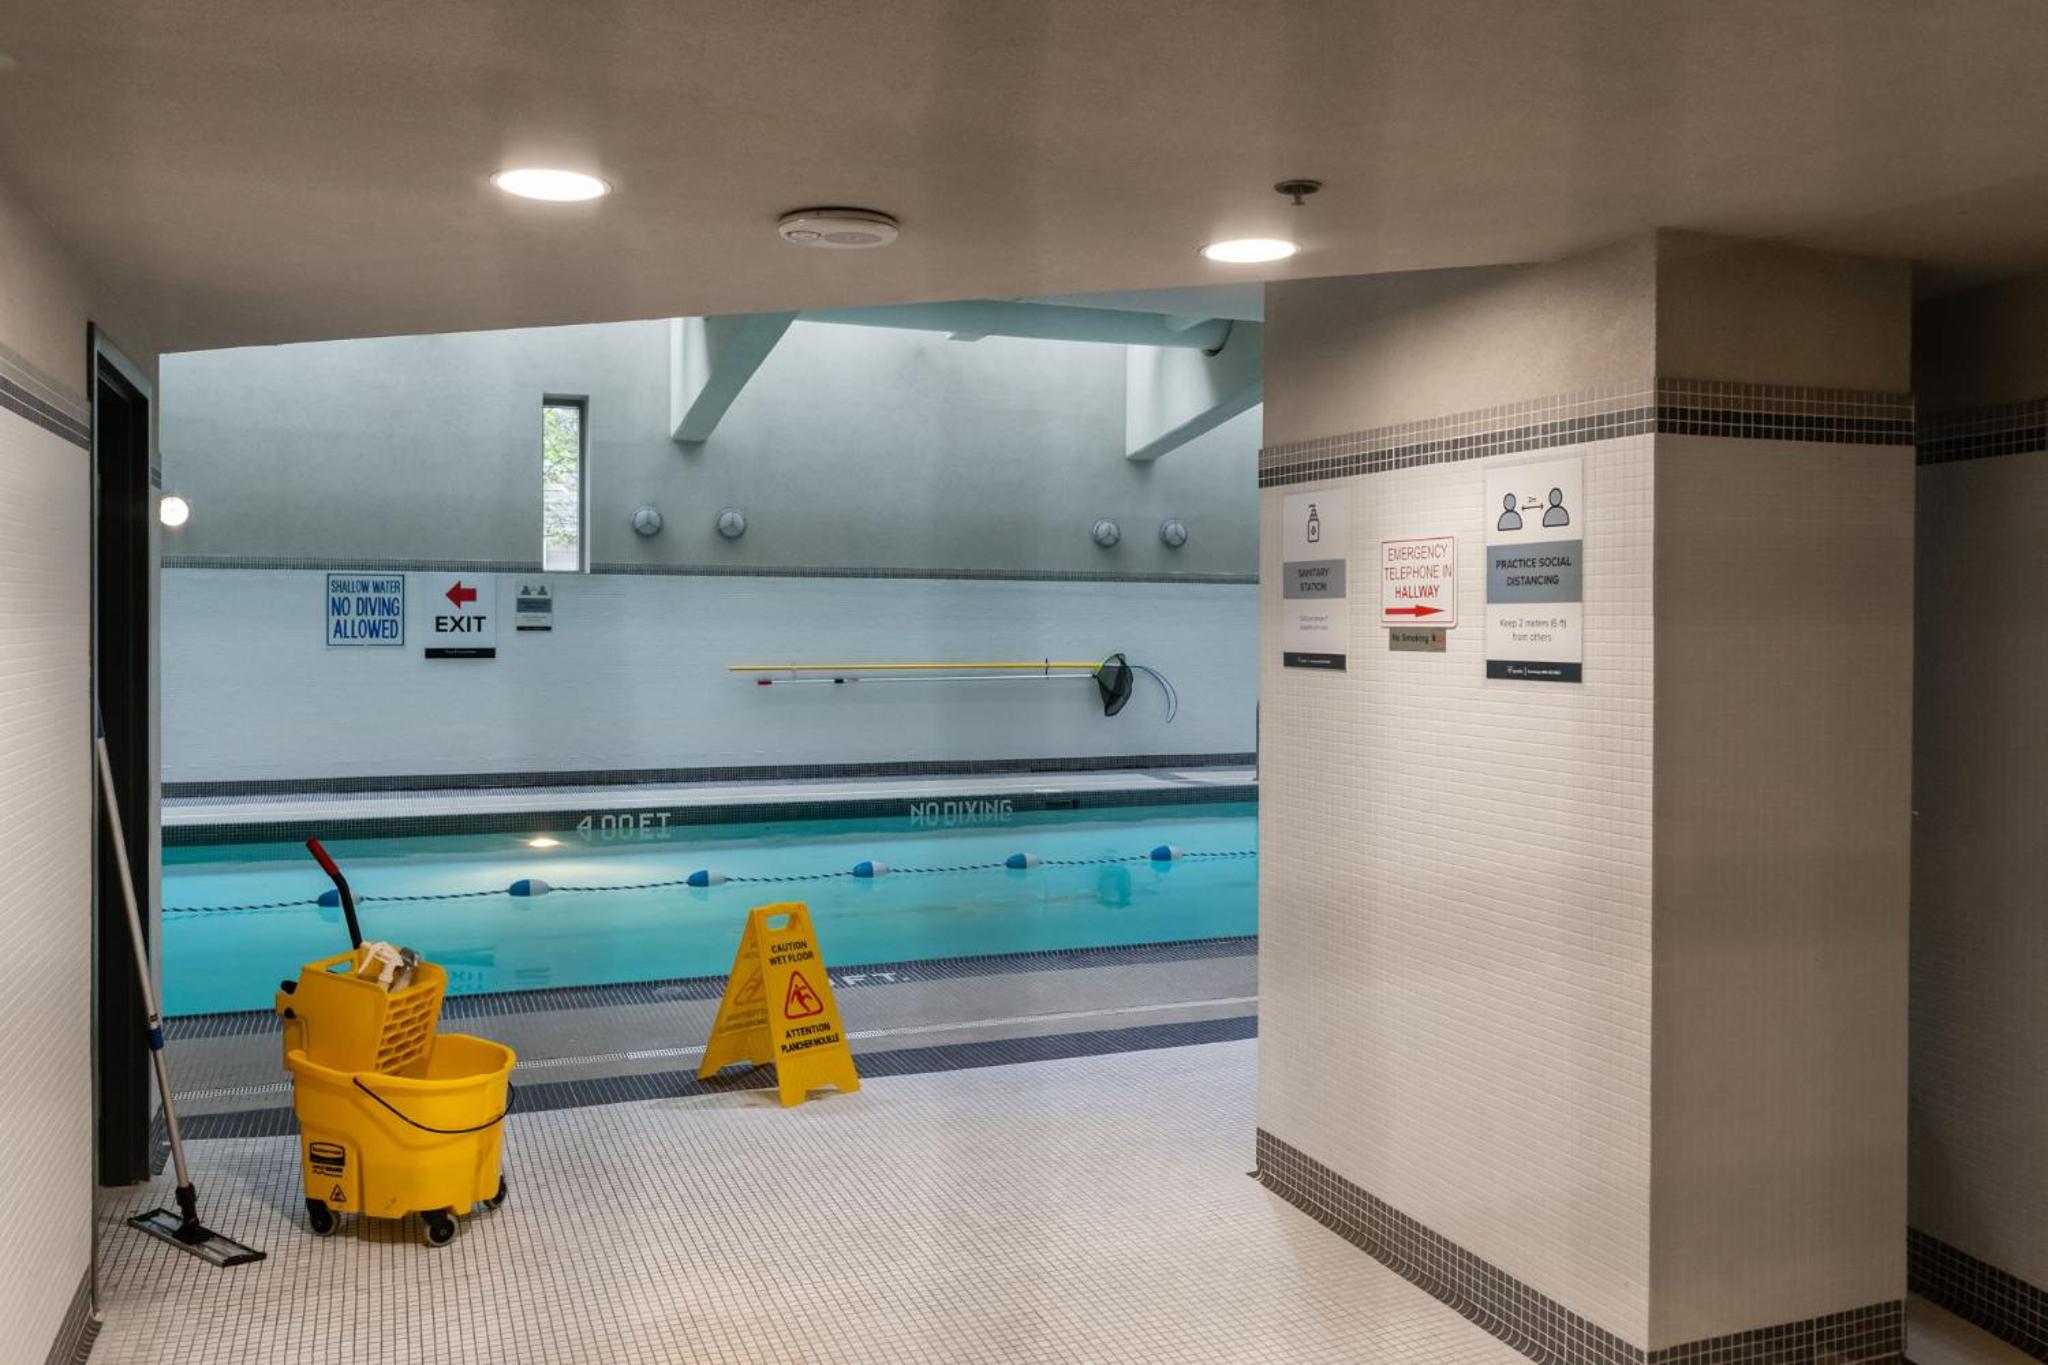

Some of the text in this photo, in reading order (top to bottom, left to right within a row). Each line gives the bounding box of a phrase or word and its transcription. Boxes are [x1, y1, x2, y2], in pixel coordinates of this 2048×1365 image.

[1387, 543, 1448, 562] EMERGENCY
[1496, 556, 1571, 570] PRACTICE SOCIAL
[1384, 562, 1452, 580] TELEPHONE IN
[331, 579, 400, 594] SHALLOW WATER
[1506, 574, 1559, 587] DISTANCING
[1395, 584, 1440, 599] HALLWAY
[331, 596, 400, 617] NO DIVING
[333, 618, 399, 639] ALLOWED
[435, 615, 487, 633] EXIT
[1500, 618, 1518, 629] Keep
[771, 940, 808, 953] CAUTION
[769, 951, 814, 966] WET FLOOR
[785, 1022, 831, 1038] ATTENTION
